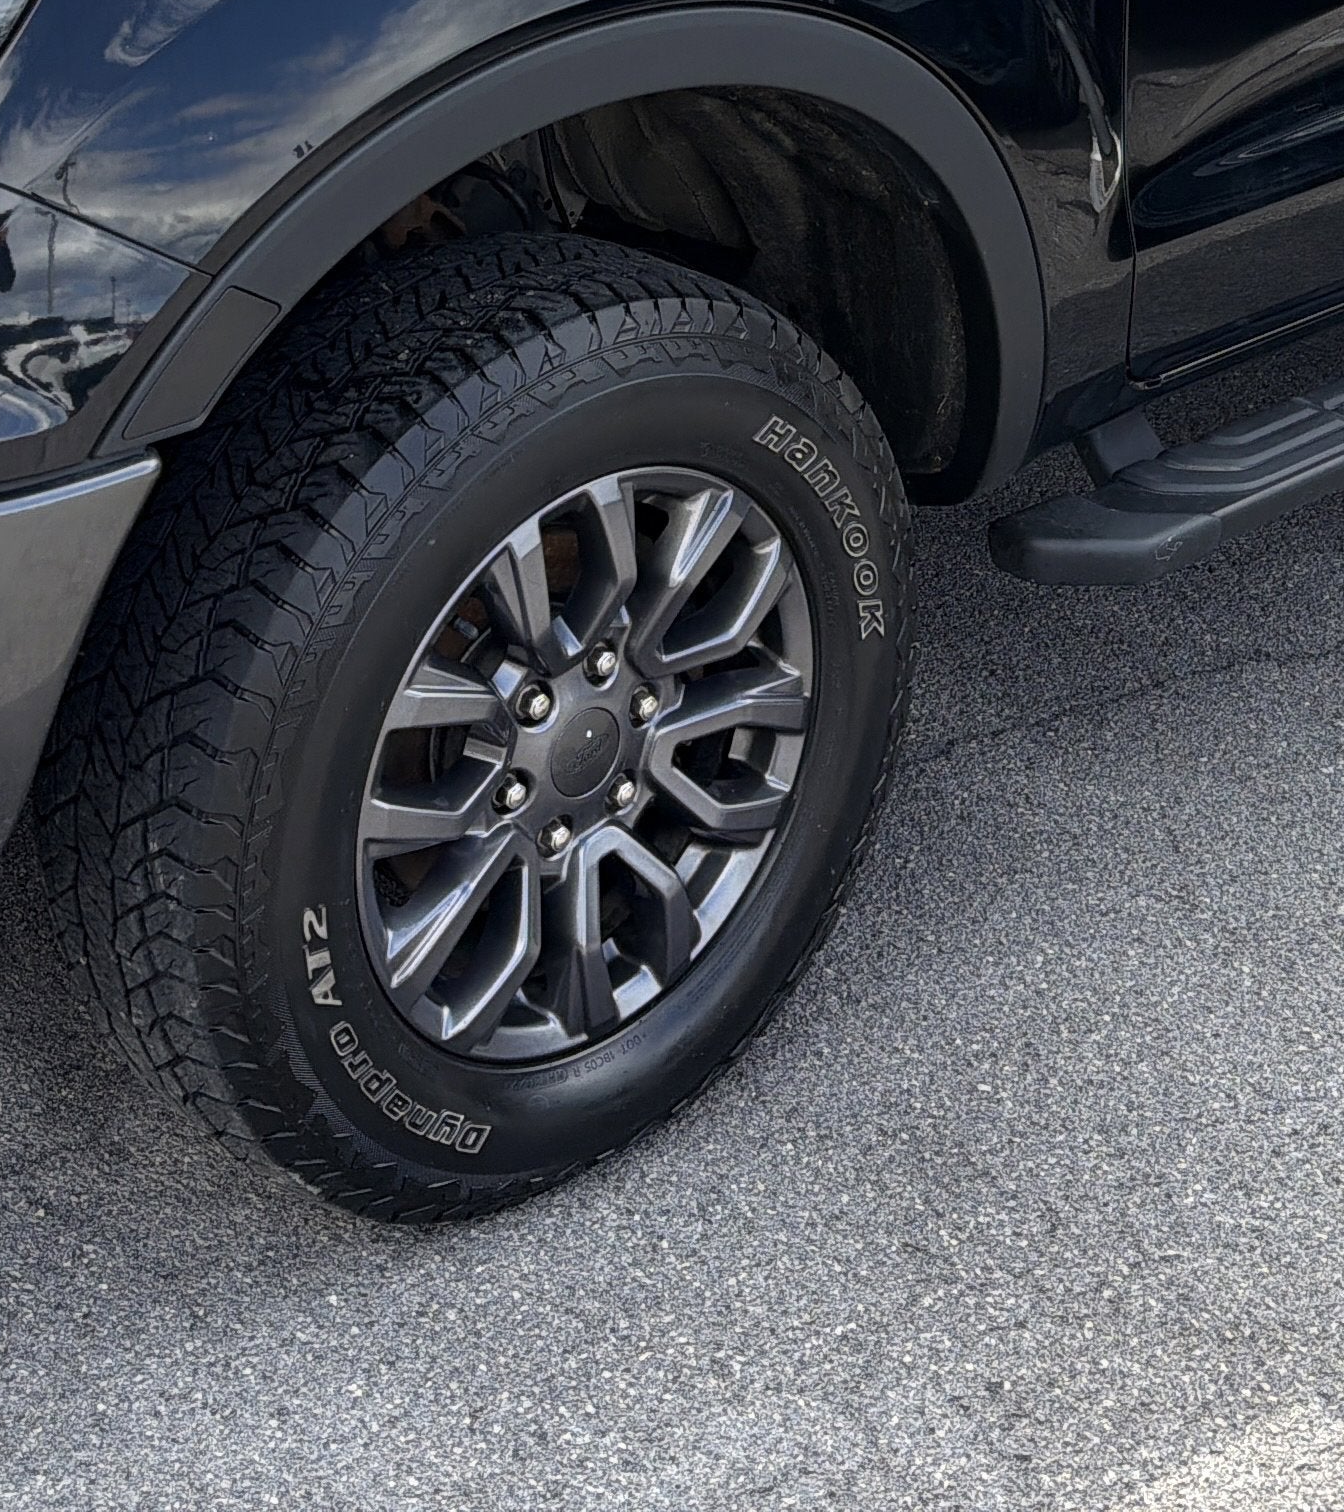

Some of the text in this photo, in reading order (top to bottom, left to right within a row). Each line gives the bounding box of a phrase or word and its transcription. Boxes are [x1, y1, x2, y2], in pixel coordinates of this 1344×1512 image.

[303, 904, 492, 1154] Dynapro AT2
[620, 1034, 643, 1055] DOT
